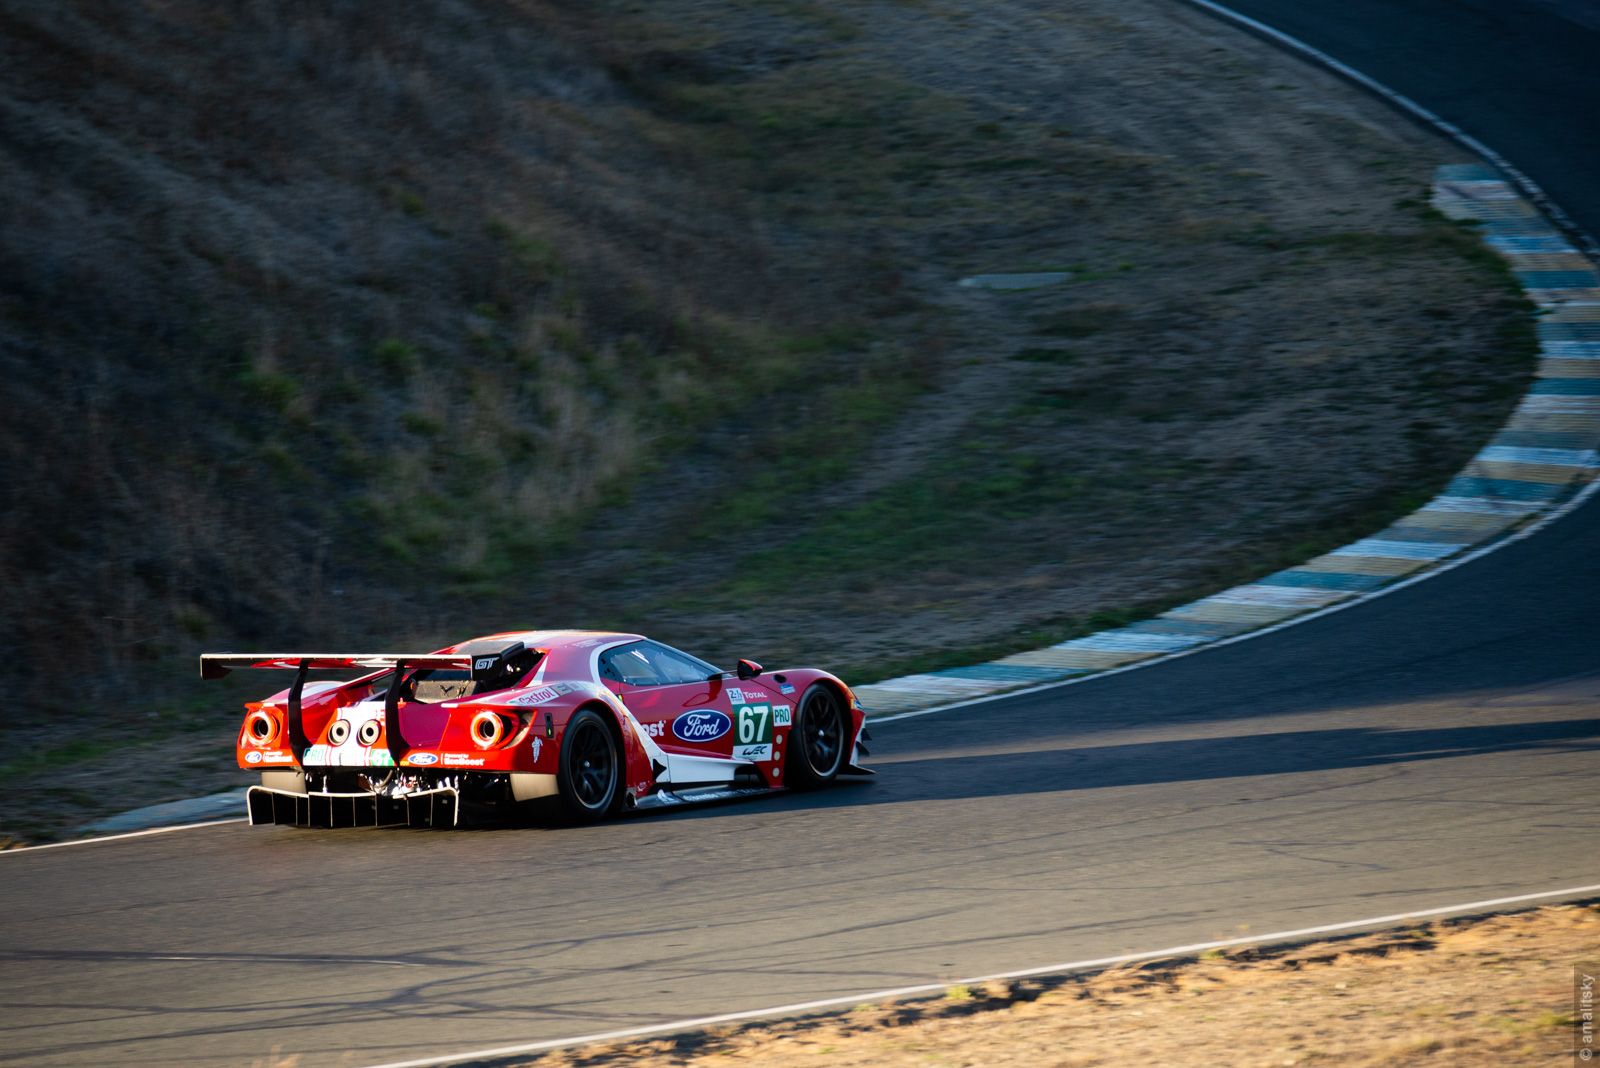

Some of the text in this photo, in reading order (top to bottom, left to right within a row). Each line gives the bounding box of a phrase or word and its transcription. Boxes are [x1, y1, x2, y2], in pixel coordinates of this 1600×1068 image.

[475, 657, 500, 670] GT
[518, 688, 555, 704] Castrol
[774, 708, 790, 723] PRO
[683, 714, 720, 737] Ford
[738, 706, 769, 744] 67
[742, 745, 768, 756] WEC
